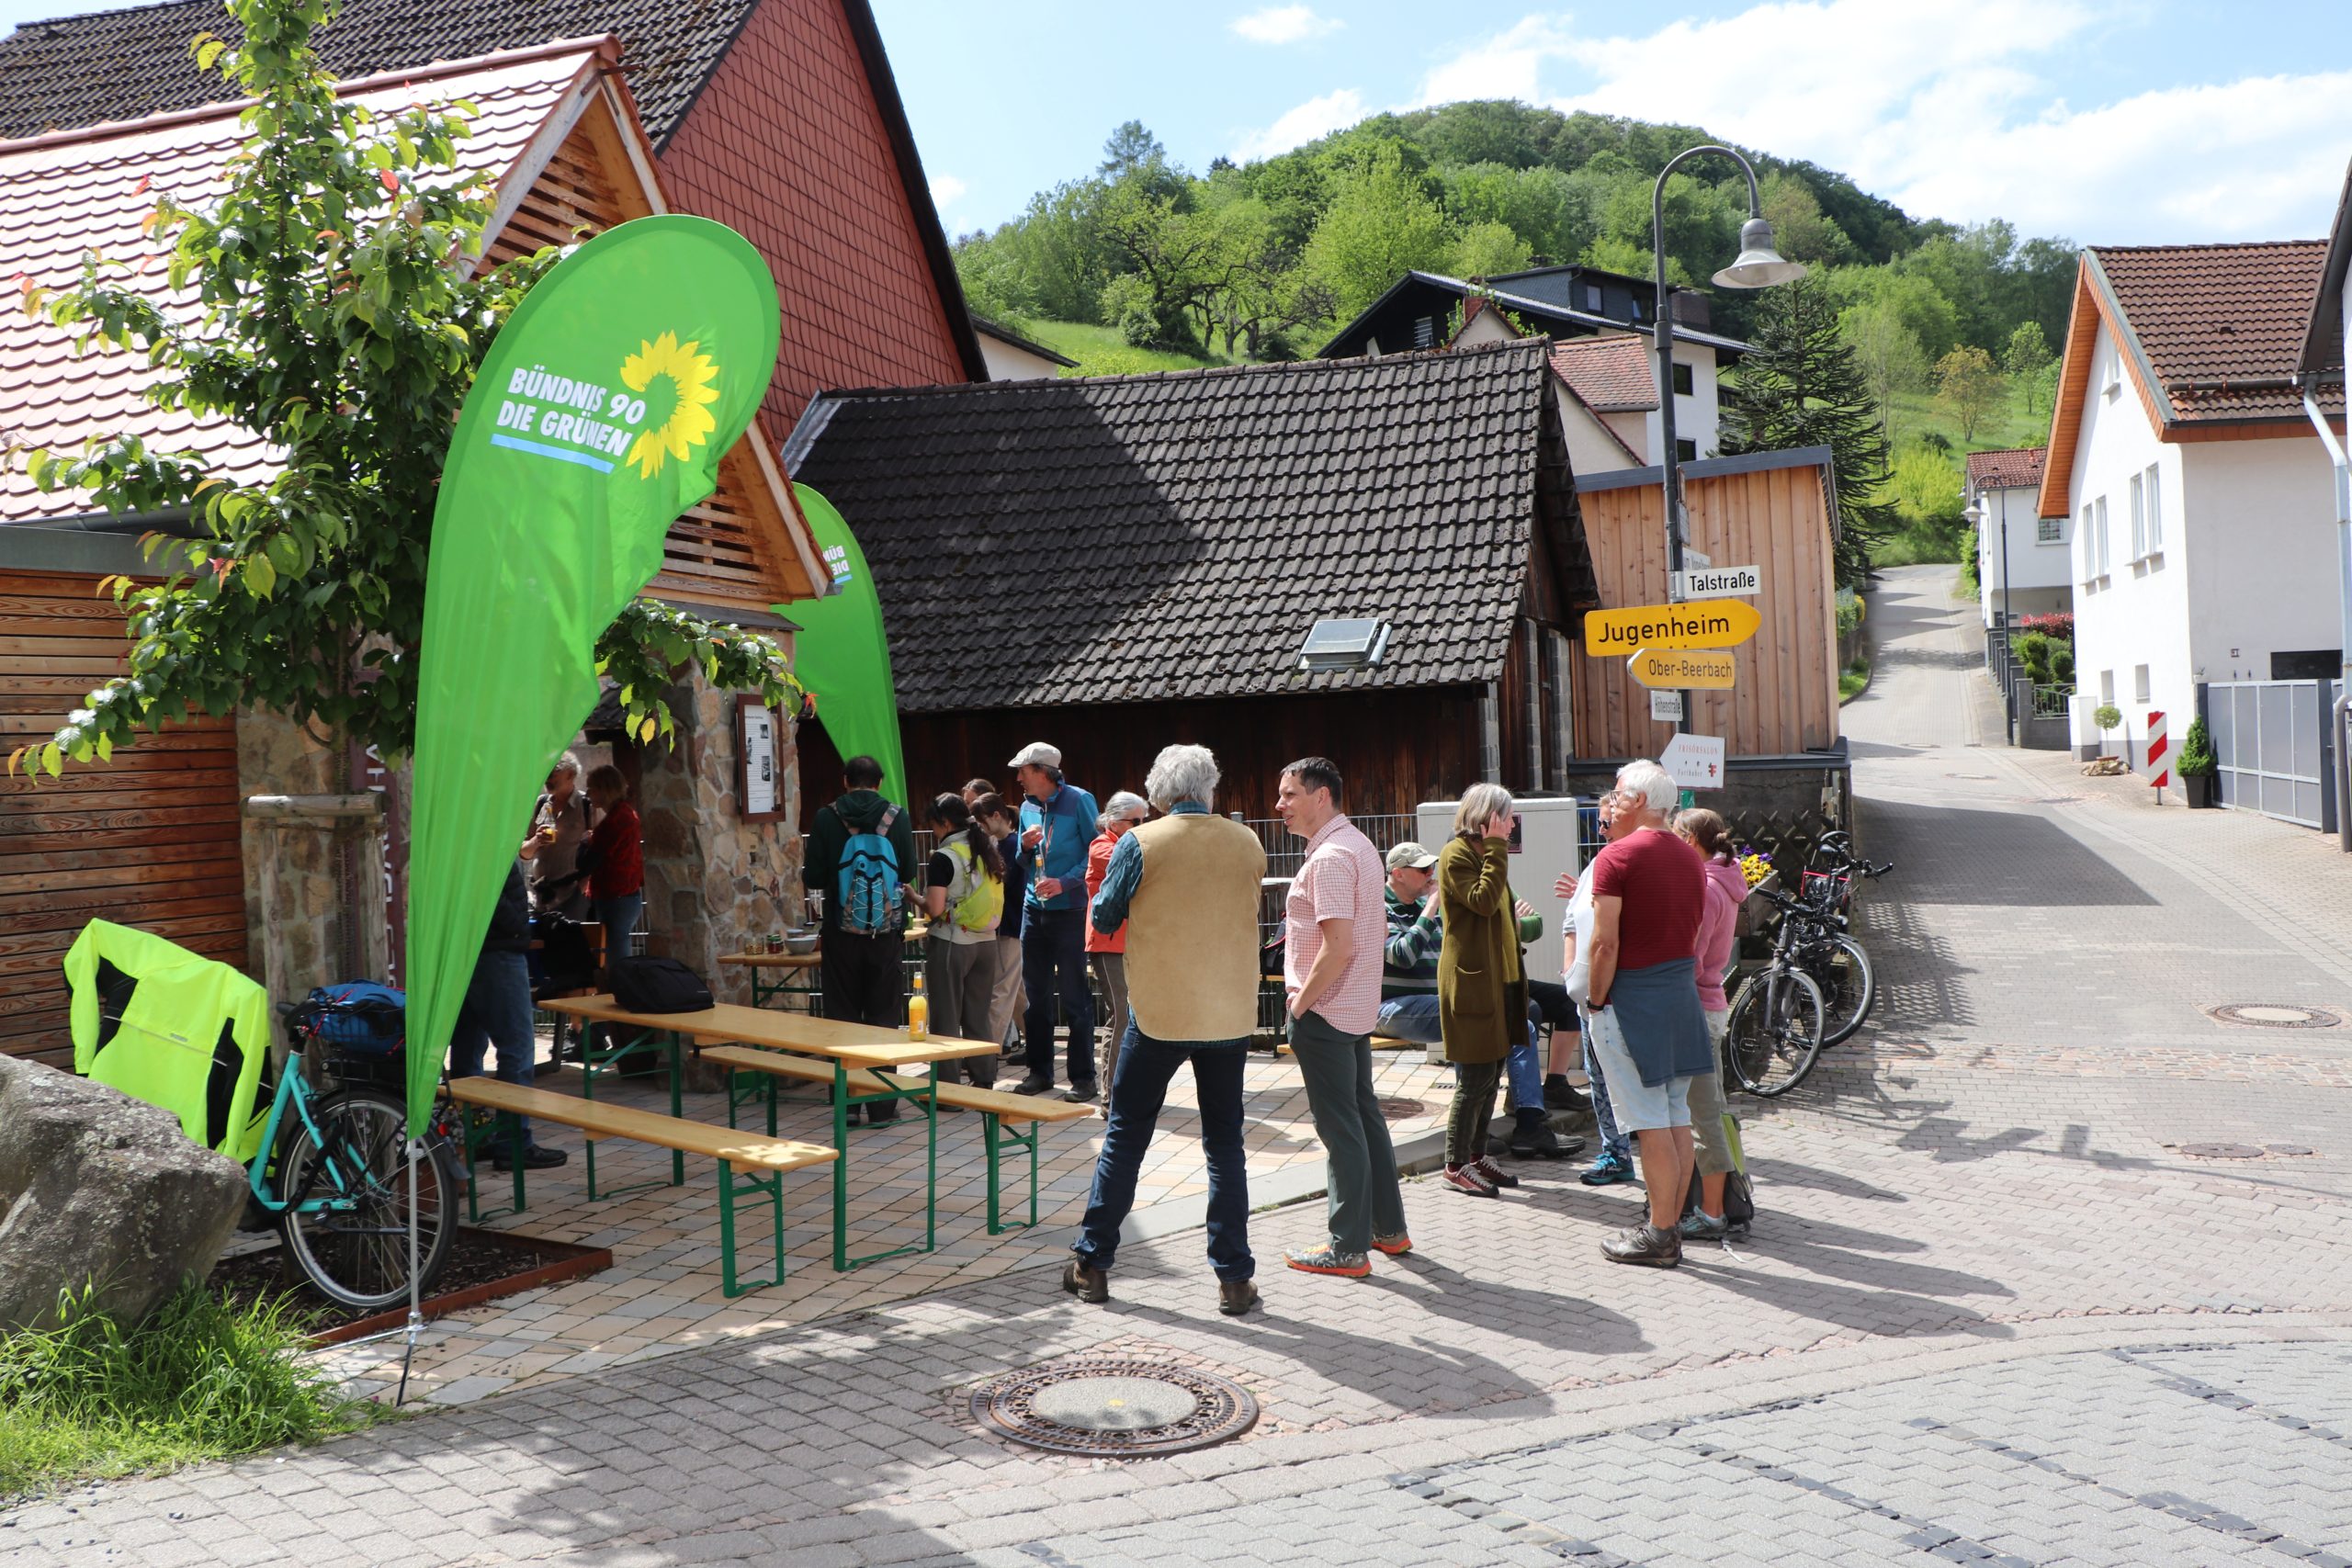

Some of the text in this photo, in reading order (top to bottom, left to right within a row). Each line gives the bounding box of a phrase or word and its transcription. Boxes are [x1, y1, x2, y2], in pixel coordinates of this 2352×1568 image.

[507, 364, 647, 426] BÜNDNIS 90
[496, 400, 633, 457] DIE GRÜNEN
[1690, 571, 1755, 592] Talstraße
[1598, 614, 1730, 646] Jugenheim
[1648, 659, 1733, 679] Ober-Beerbach
